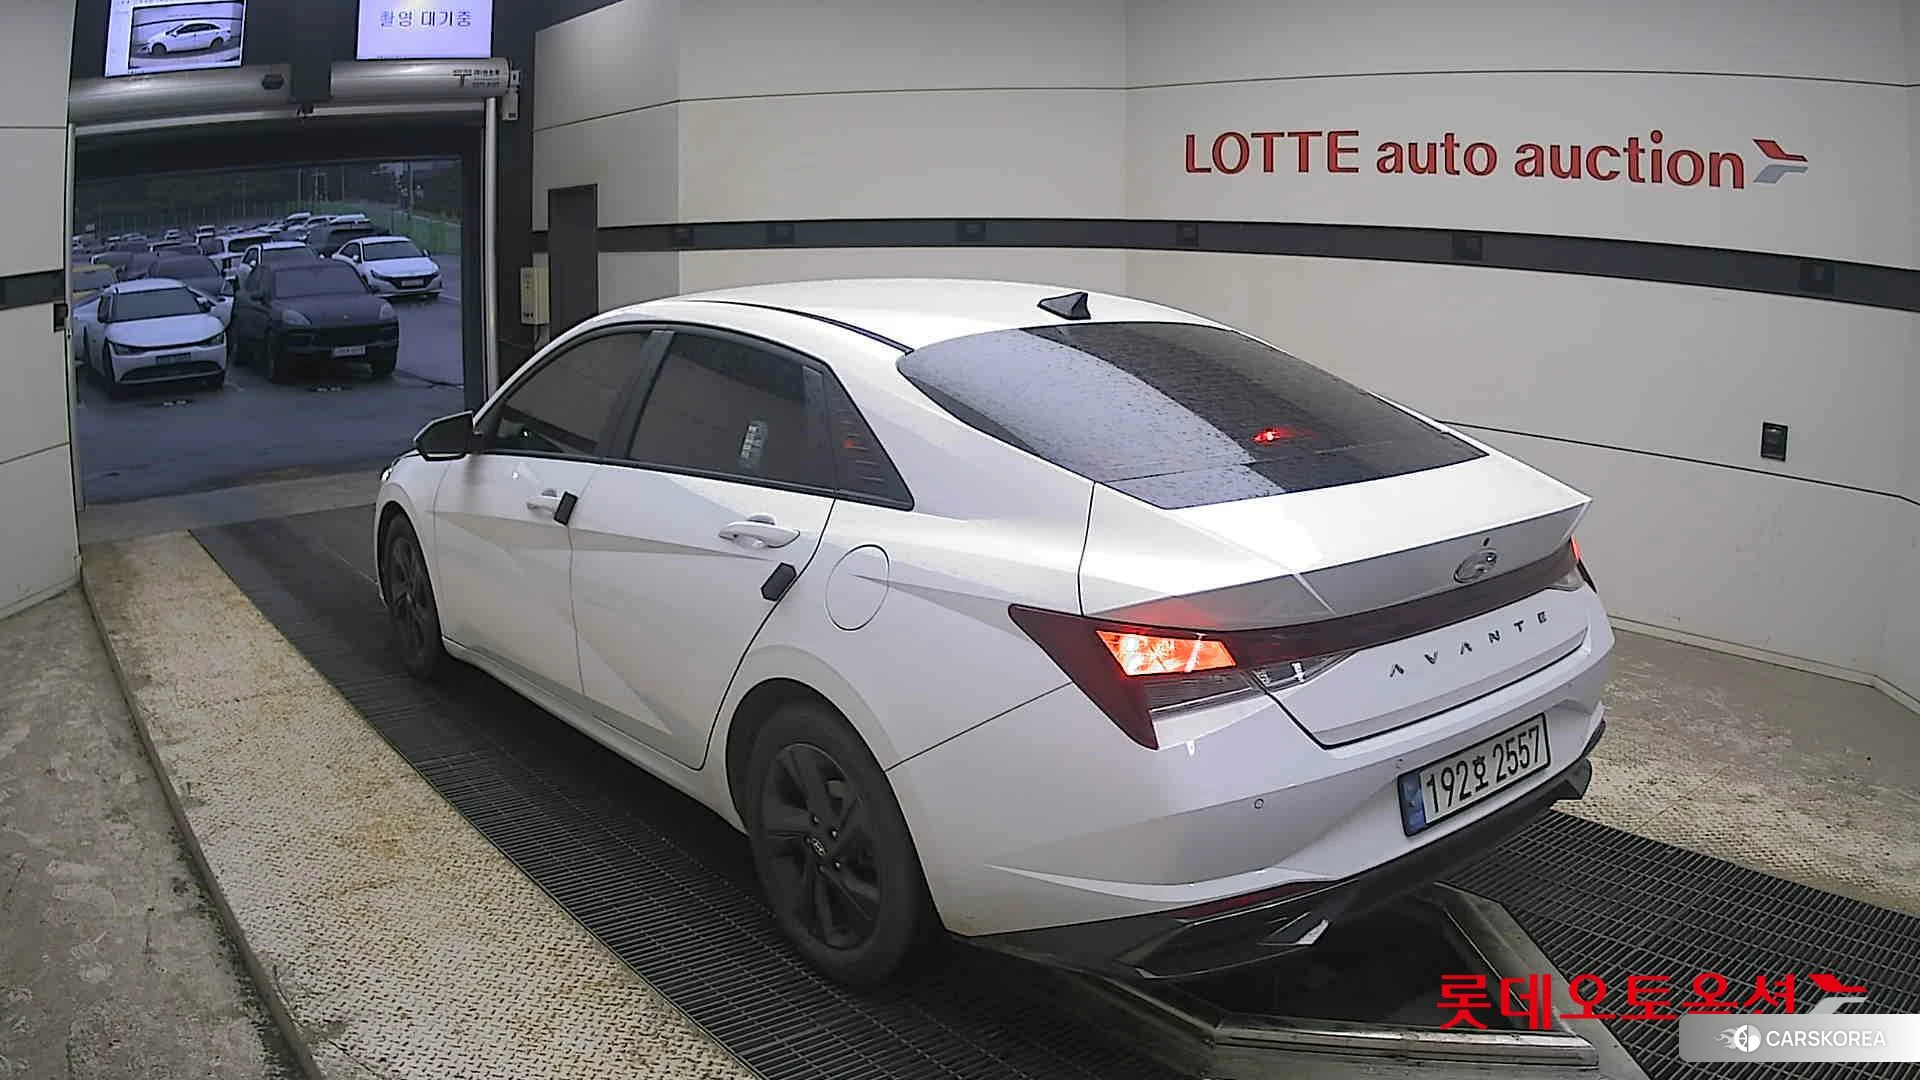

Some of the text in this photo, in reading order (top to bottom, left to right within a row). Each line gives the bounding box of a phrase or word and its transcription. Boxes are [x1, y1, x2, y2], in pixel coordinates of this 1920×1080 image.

[420, 10, 473, 28] 대기중
[1185, 129, 1745, 190] LOTTE auto auction
[1389, 610, 1549, 678] AVANTE
[1426, 725, 1540, 813] 192호 2557
